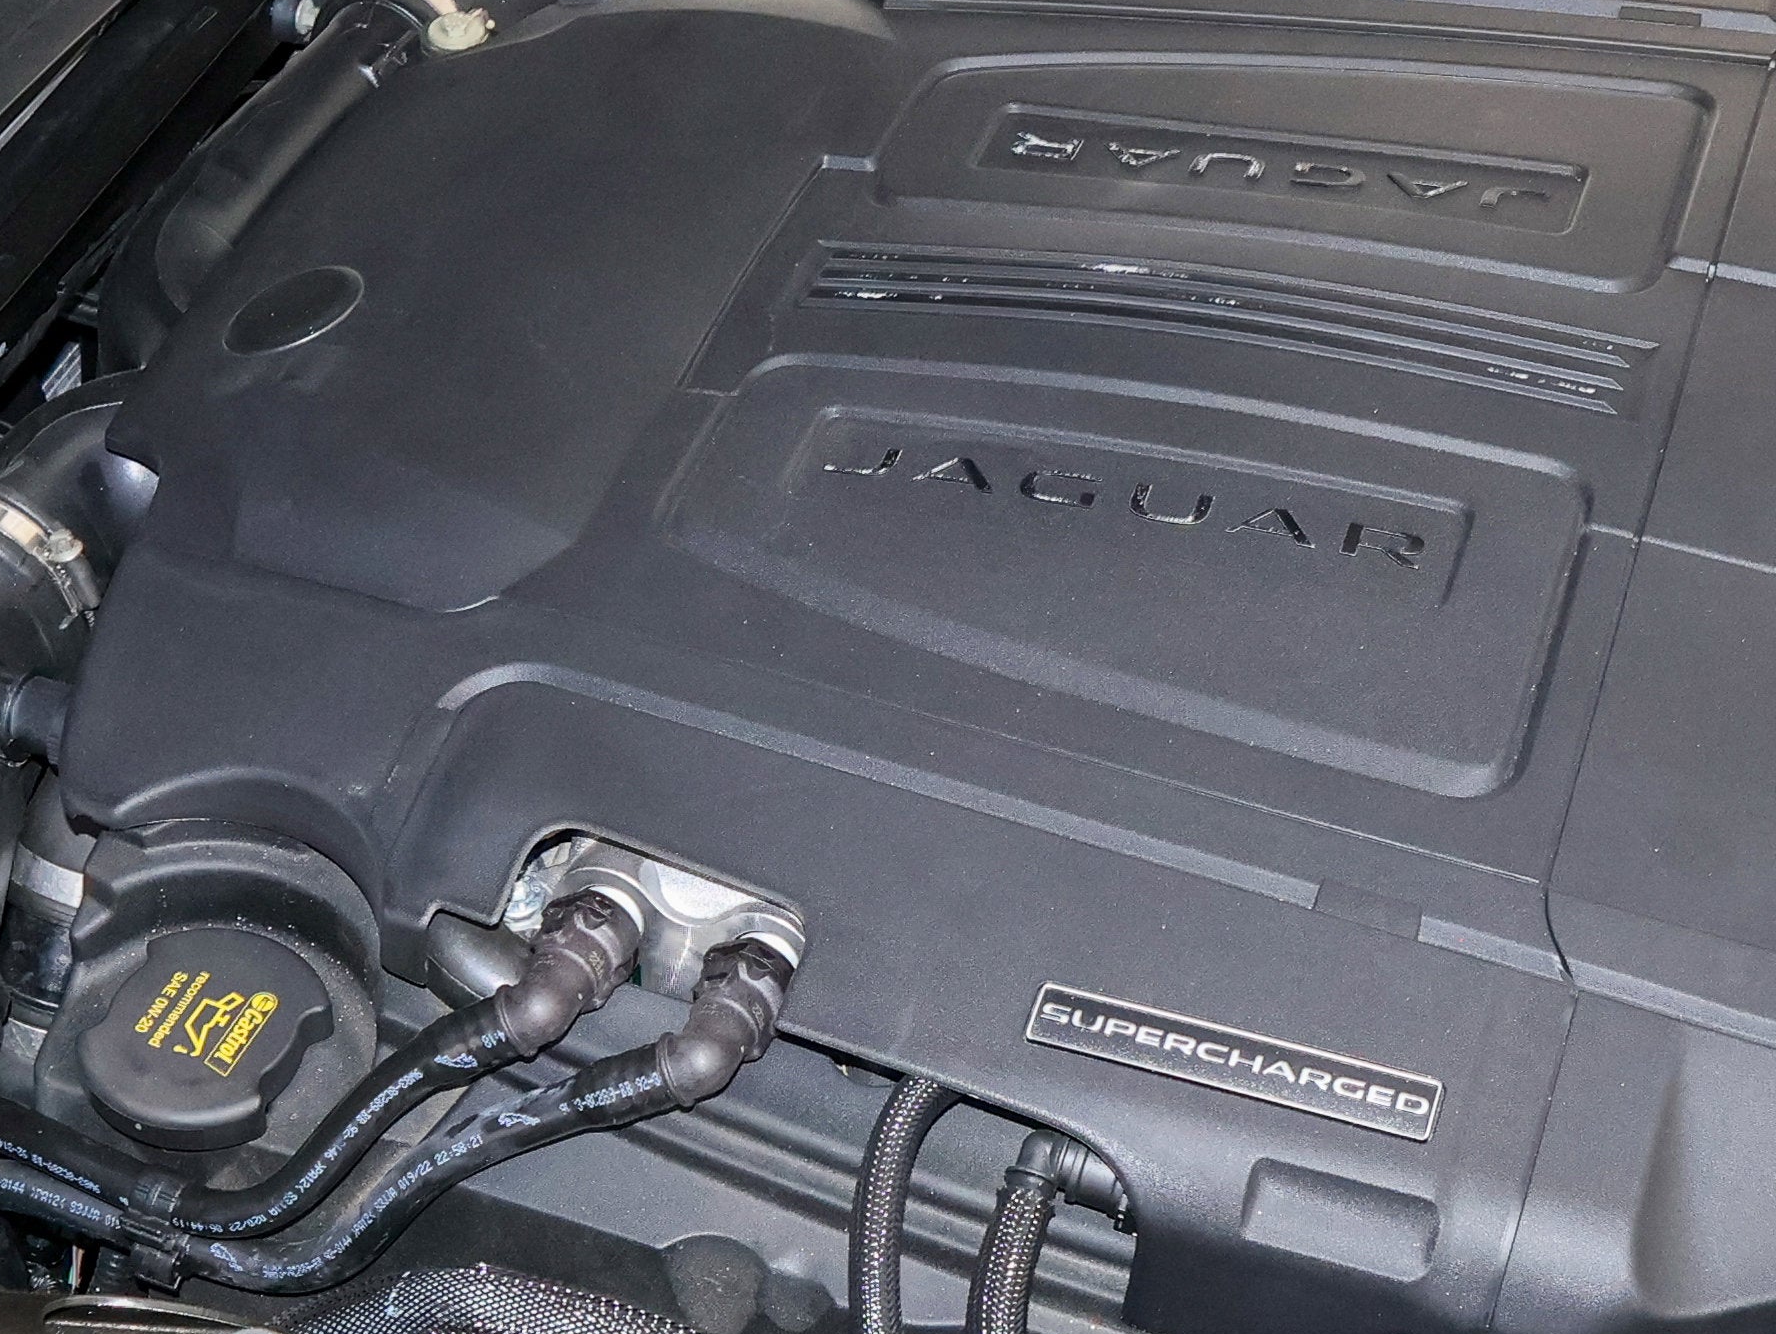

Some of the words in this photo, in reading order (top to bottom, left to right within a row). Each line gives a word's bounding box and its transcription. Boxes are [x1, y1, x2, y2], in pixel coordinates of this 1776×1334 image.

[1011, 130, 1550, 209] JAGUAR
[822, 446, 1426, 570] JAGUAR
[147, 970, 212, 1049] recommended
[160, 970, 190, 998] SAE
[213, 1008, 264, 1064] Castrol
[1039, 1002, 1430, 1116] SUPERCHARGED
[433, 1133, 485, 1167] 22:58:21
